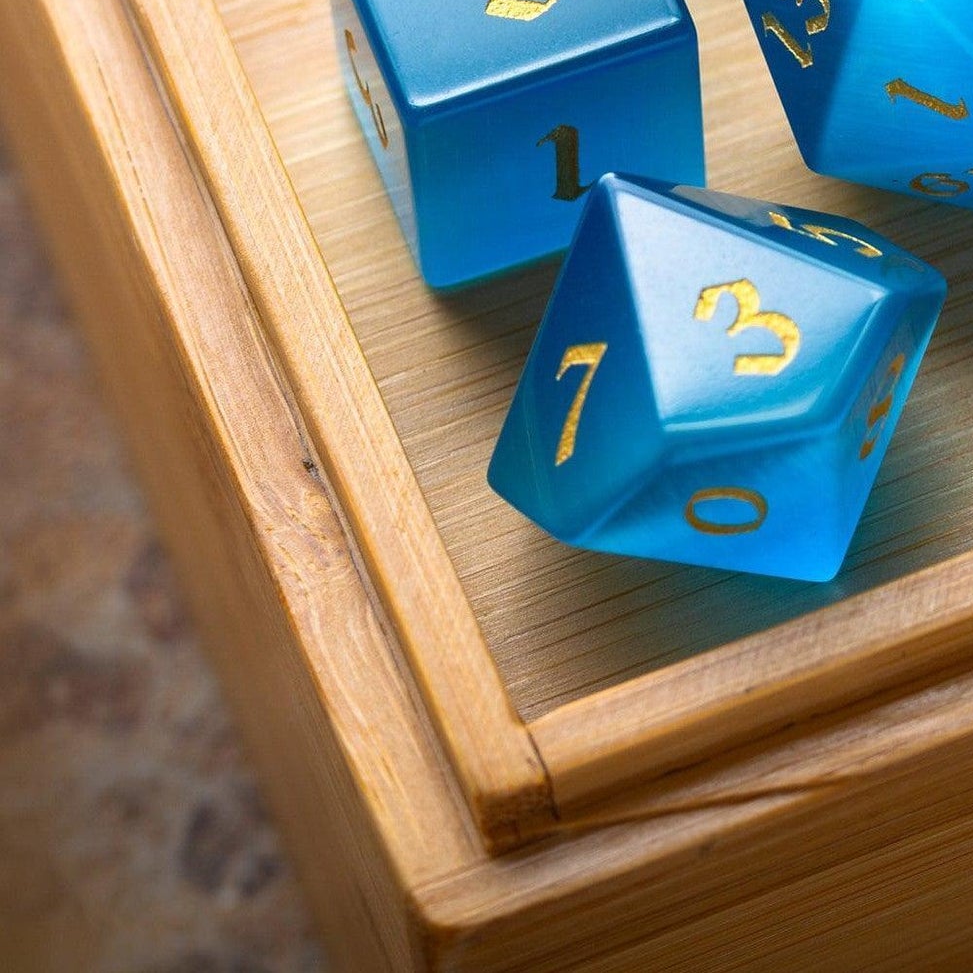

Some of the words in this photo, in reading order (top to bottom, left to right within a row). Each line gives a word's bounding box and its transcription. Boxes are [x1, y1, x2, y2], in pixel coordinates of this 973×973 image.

[884, 78, 969, 121] 1
[536, 123, 600, 202] 1
[693, 278, 801, 375] 3
[555, 342, 608, 466] 7
[684, 486, 768, 535] 0
